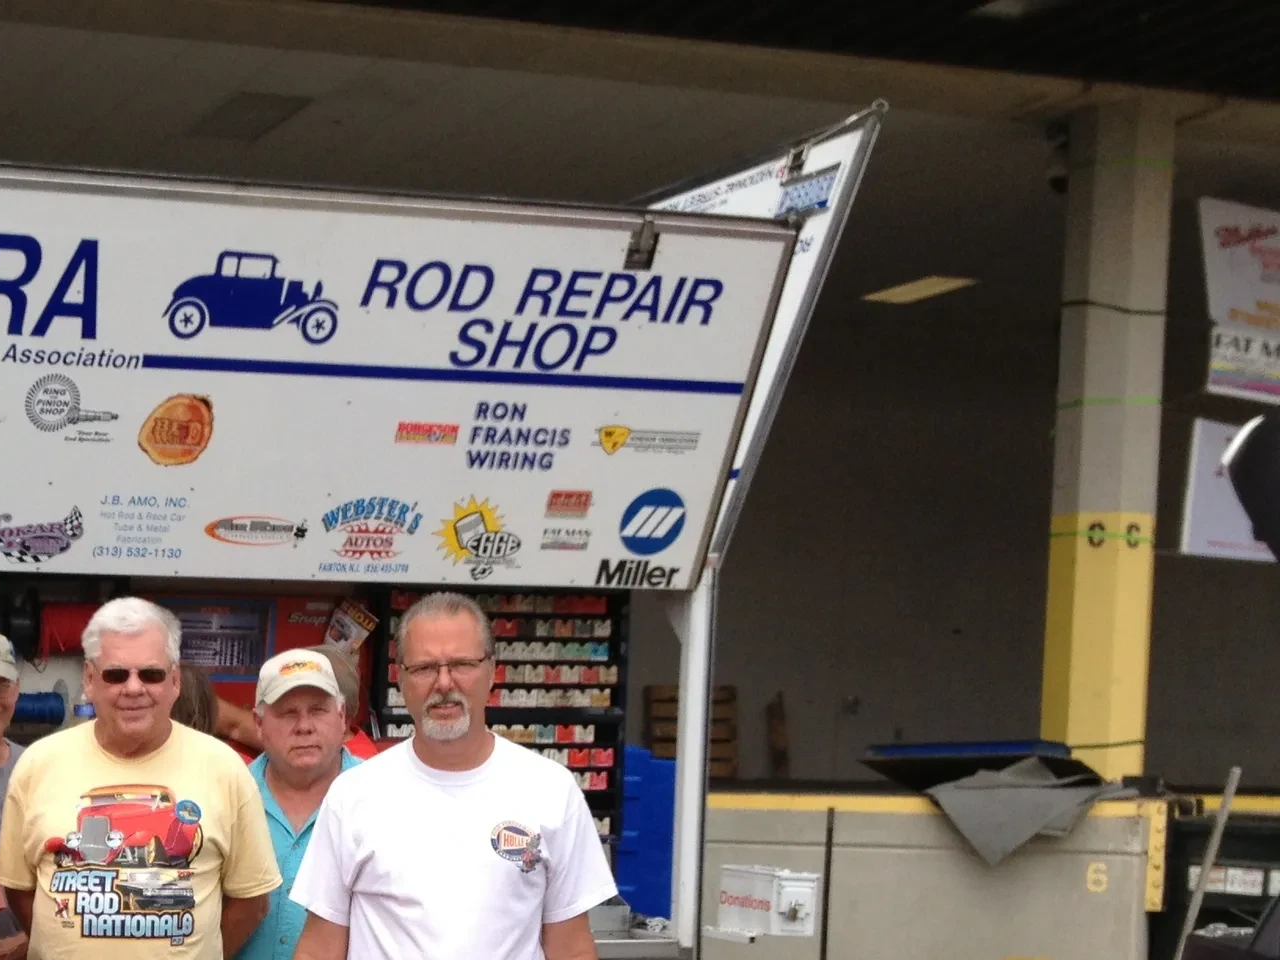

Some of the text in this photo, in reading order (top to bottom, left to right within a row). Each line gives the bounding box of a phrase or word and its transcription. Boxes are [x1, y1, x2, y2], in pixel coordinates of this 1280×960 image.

[359, 258, 725, 325] ROD REPAIR
[3, 342, 143, 369] Association
[448, 319, 618, 372] SHOP
[42, 387, 67, 396] RING
[35, 399, 70, 409] PINION
[38, 407, 65, 416] SHOP
[473, 401, 528, 422] RON
[468, 425, 572, 447] FRANCIS
[466, 450, 555, 471] WIRING
[100, 495, 124, 505] J.B.
[322, 496, 424, 534] WEBSTER'S
[92, 545, 183, 560] (313) 532-1130
[342, 536, 394, 548] AUTOS
[467, 531, 521, 557] EGGE
[595, 558, 682, 588] Miller
[50, 870, 118, 893] STREET
[1086, 862, 1110, 893] 6
[74, 891, 120, 915] ROD
[719, 890, 773, 913] Donations
[82, 911, 195, 938] NATIONALS
